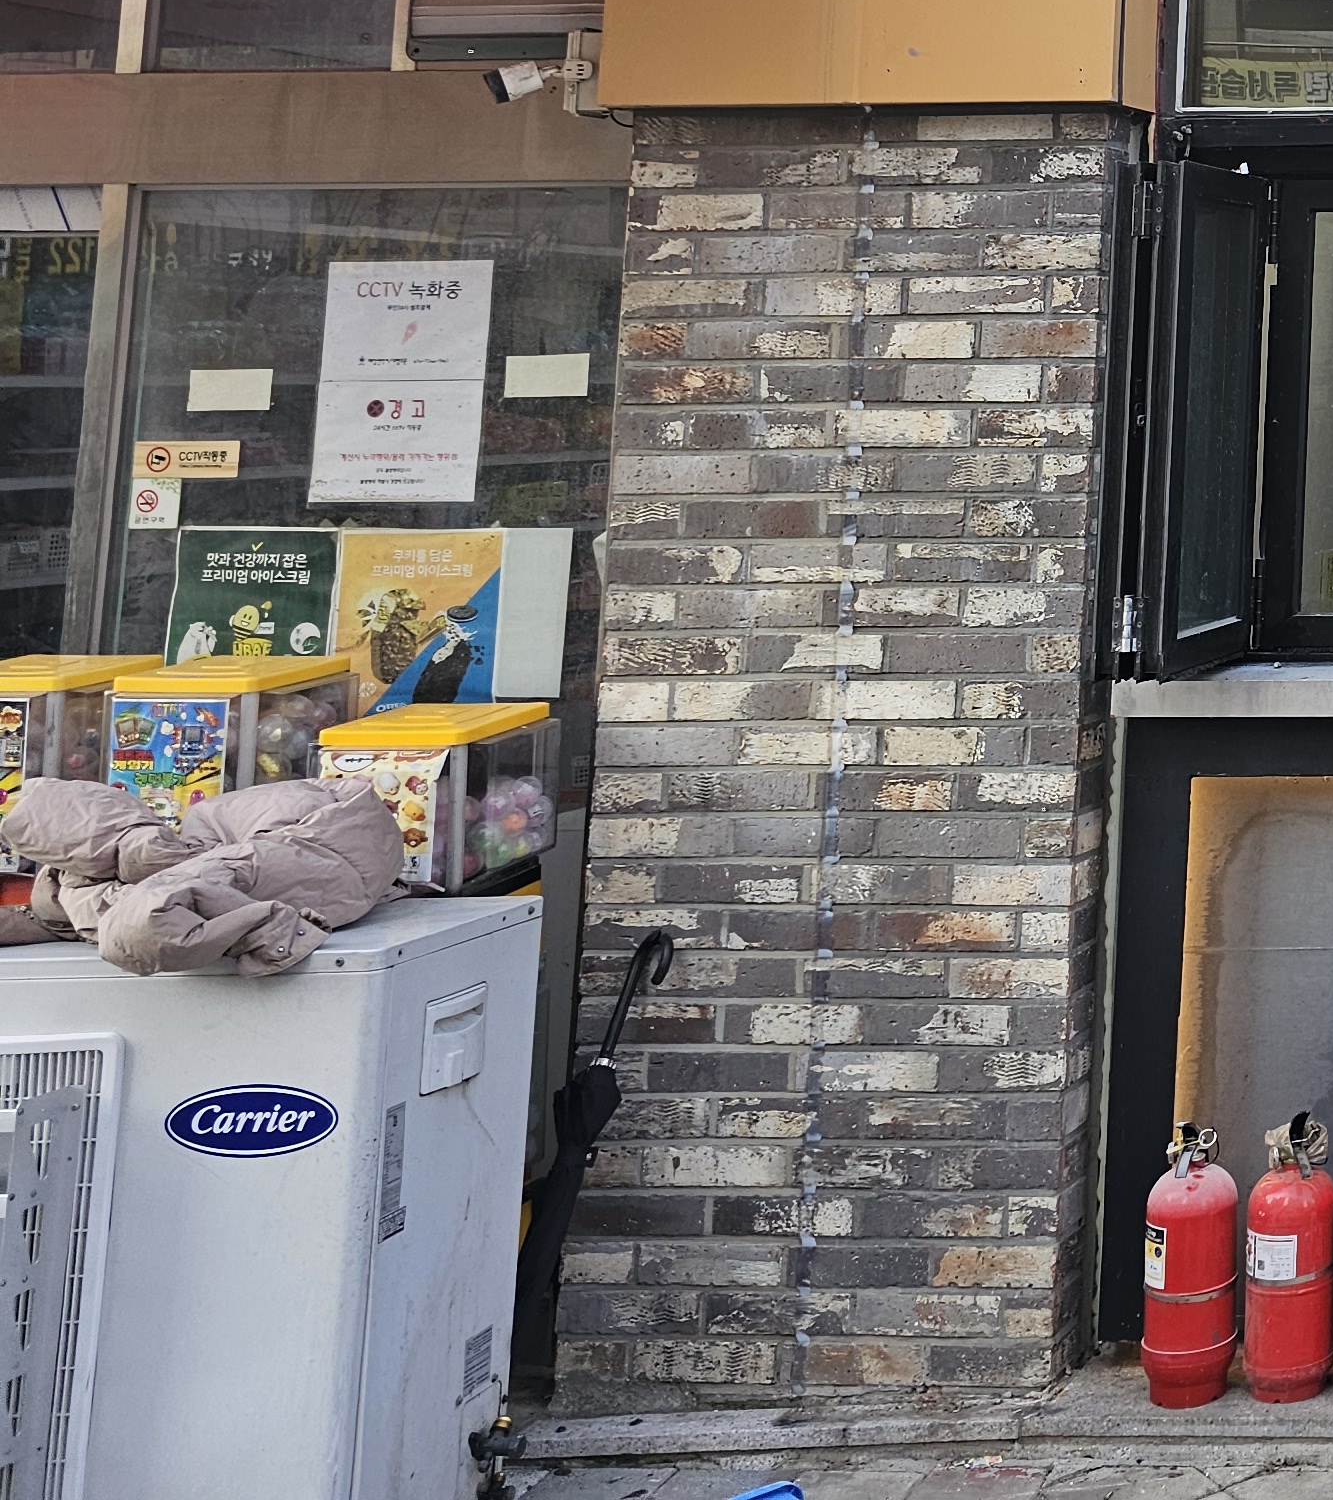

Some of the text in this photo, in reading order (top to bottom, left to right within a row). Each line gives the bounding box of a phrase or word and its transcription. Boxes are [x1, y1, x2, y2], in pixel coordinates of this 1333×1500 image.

[357, 280, 463, 300] CCTV 녹화중
[206, 552, 308, 568] 맛과 건강까지 잡은
[200, 569, 311, 585] 프리미엄 아이스크림
[370, 563, 474, 578] 프리미엄 아이스크림
[190, 1103, 316, 1139] Carrier
